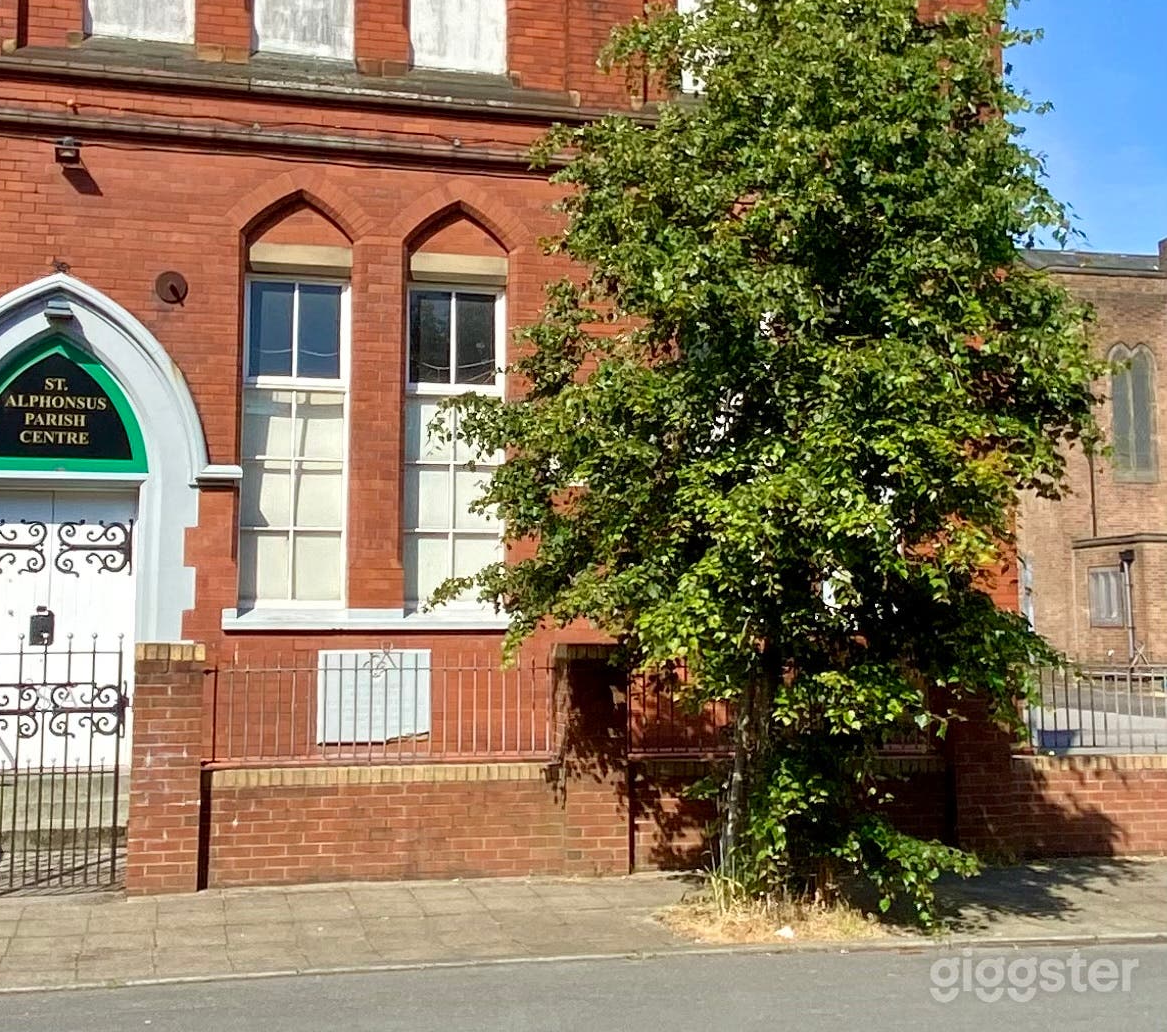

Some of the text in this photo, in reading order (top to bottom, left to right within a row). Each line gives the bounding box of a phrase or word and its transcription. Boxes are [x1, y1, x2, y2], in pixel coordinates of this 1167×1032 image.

[43, 377, 69, 392] ST.
[4, 394, 108, 411] ALPHONSUS
[24, 412, 88, 427] PARISH
[19, 430, 90, 445] CENTRE
